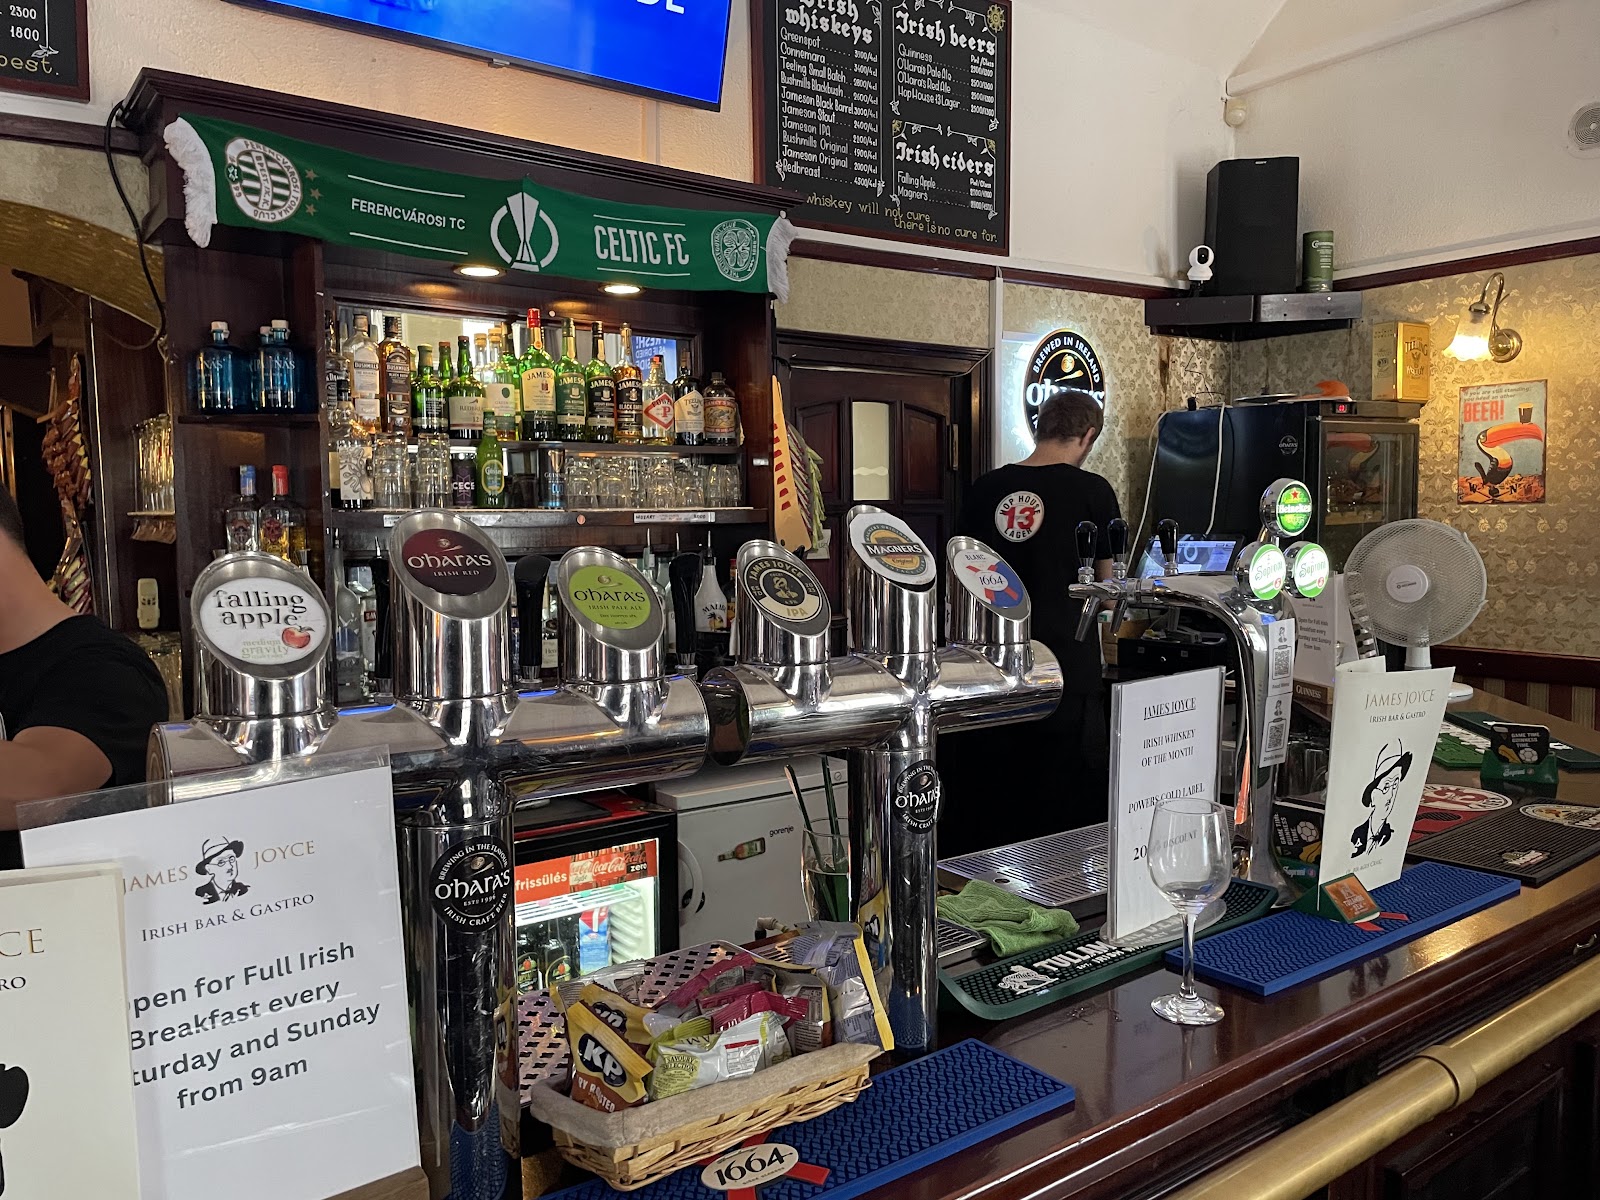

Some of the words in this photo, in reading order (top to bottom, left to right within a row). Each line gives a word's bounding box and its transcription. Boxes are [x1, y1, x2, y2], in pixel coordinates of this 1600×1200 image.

[9, 5, 37, 20] 2300
[10, 25, 40, 41] 1800
[785, 5, 873, 45] whiskeys
[896, 11, 945, 47] Irish
[949, 24, 995, 56] beers
[780, 26, 821, 50] Greenspot
[780, 41, 825, 64] Connemara
[780, 55, 807, 77] Teeling
[808, 62, 826, 79] Small
[827, 67, 846, 84] Batch
[780, 70, 811, 90] Bushmills
[926, 64, 941, 79] Pale
[941, 68, 952, 81] Ale
[927, 78, 940, 92] Red
[940, 81, 951, 94] Ale
[781, 86, 815, 106] Jameson
[815, 94, 833, 110] Black
[898, 85, 912, 102] Hop
[912, 88, 935, 104] House
[941, 95, 960, 111] Lager
[782, 100, 817, 120] Jameson
[817, 108, 836, 124] Stout
[782, 115, 817, 135] Jameson
[782, 129, 818, 149] Bushmills
[819, 137, 849, 155] Original
[782, 144, 818, 163] Jameson
[819, 152, 849, 170] Original
[782, 157, 821, 179] Redbreast
[896, 141, 940, 171] Irish
[942, 151, 994, 177] ciders
[897, 170, 919, 189] Falling
[920, 174, 936, 191] Apple
[806, 192, 852, 214] whiskey
[858, 202, 879, 215] will
[897, 185, 928, 201] Magners
[253, 209, 277, 220] CLUB
[351, 198, 447, 228] FERENCVÁROSI
[449, 216, 466, 230] TC
[894, 217, 924, 232] there
[927, 222, 936, 233] is
[938, 226, 951, 236] no
[954, 228, 978, 240] cure
[594, 225, 659, 264] CELTIC
[663, 233, 690, 265] FC
[1033, 337, 1061, 374] BREWED
[1063, 336, 1074, 347] IN
[1075, 339, 1100, 383] IRELAND
[1463, 400, 1505, 423] BEER!
[999, 498, 1014, 515] HOP
[1018, 495, 1041, 514] HOUSE
[1003, 506, 1036, 530] 13
[1004, 527, 1032, 539] LAGER
[866, 544, 923, 555] MAGNERS
[749, 560, 771, 581] JAMES
[771, 560, 805, 579] JOYCE
[979, 575, 1006, 586] 1664
[212, 589, 308, 614] falling
[786, 607, 809, 617] IPA
[221, 608, 299, 630] apple
[1296, 684, 1322, 699] GUINNESS
[1364, 693, 1403, 710] JAMES
[1404, 689, 1436, 708] JOYCE
[1144, 703, 1170, 719] JAMES
[1170, 697, 1197, 714] JOYCE
[1369, 715, 1387, 723] IRISH
[1143, 737, 1164, 749] IRISH
[1165, 729, 1196, 744] WHISKEY
[1141, 757, 1153, 767] OF
[1153, 753, 1167, 765] THE
[1168, 746, 1194, 761] MONTH
[1128, 794, 1160, 814] POWERS
[1183, 782, 1205, 797] LABEL
[769, 824, 795, 838] gorenje
[122, 866, 188, 896] JAMES
[254, 840, 315, 869] JOYCE
[438, 850, 465, 880] BREWING
[465, 845, 475, 854] IN
[630, 863, 647, 872] zero
[514, 872, 568, 891] frissülés
[142, 921, 188, 942] IRISH
[195, 913, 228, 931] BAR
[232, 908, 246, 921] &
[250, 893, 314, 917] GASTRO
[443, 906, 467, 925] IRISH
[469, 911, 496, 926] CRAFT
[496, 893, 508, 913] BEER
[133, 987, 187, 1018] pen
[195, 974, 236, 998] for
[243, 955, 293, 986] Full
[300, 942, 355, 971] Irish
[131, 1000, 261, 1051] Breakfast
[268, 981, 340, 1013] every
[133, 1047, 222, 1087] turday
[230, 1027, 279, 1058] and
[287, 1003, 381, 1042] Sunday
[584, 1039, 624, 1077] KP
[177, 1076, 243, 1109] from
[250, 1058, 308, 1087] 9am
[714, 1147, 793, 1186] 1664
